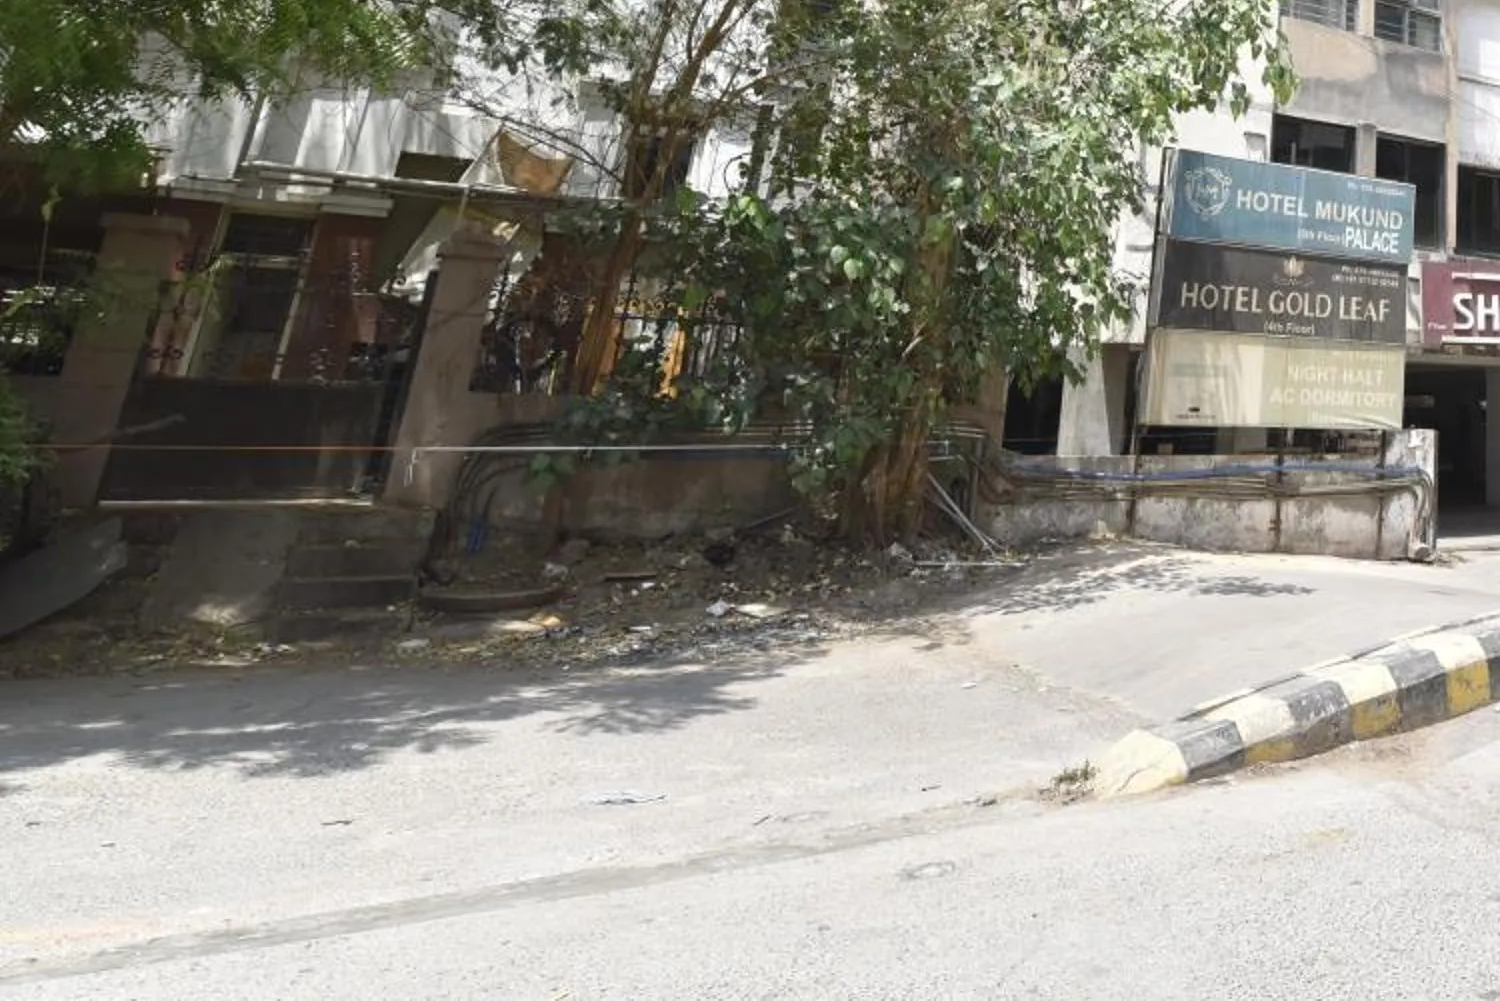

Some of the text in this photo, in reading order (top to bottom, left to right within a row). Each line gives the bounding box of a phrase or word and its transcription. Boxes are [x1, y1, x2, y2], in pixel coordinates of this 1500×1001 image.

[1236, 189, 1309, 218] HOTEL
[1315, 200, 1403, 231] MUKUND
[1344, 225, 1400, 254] PALACE
[1180, 282, 1392, 323] HOTEL GOLD LEAF
[1287, 365, 1385, 386] NIGHT HALT
[1269, 387, 1398, 408] AC DORMITORY
